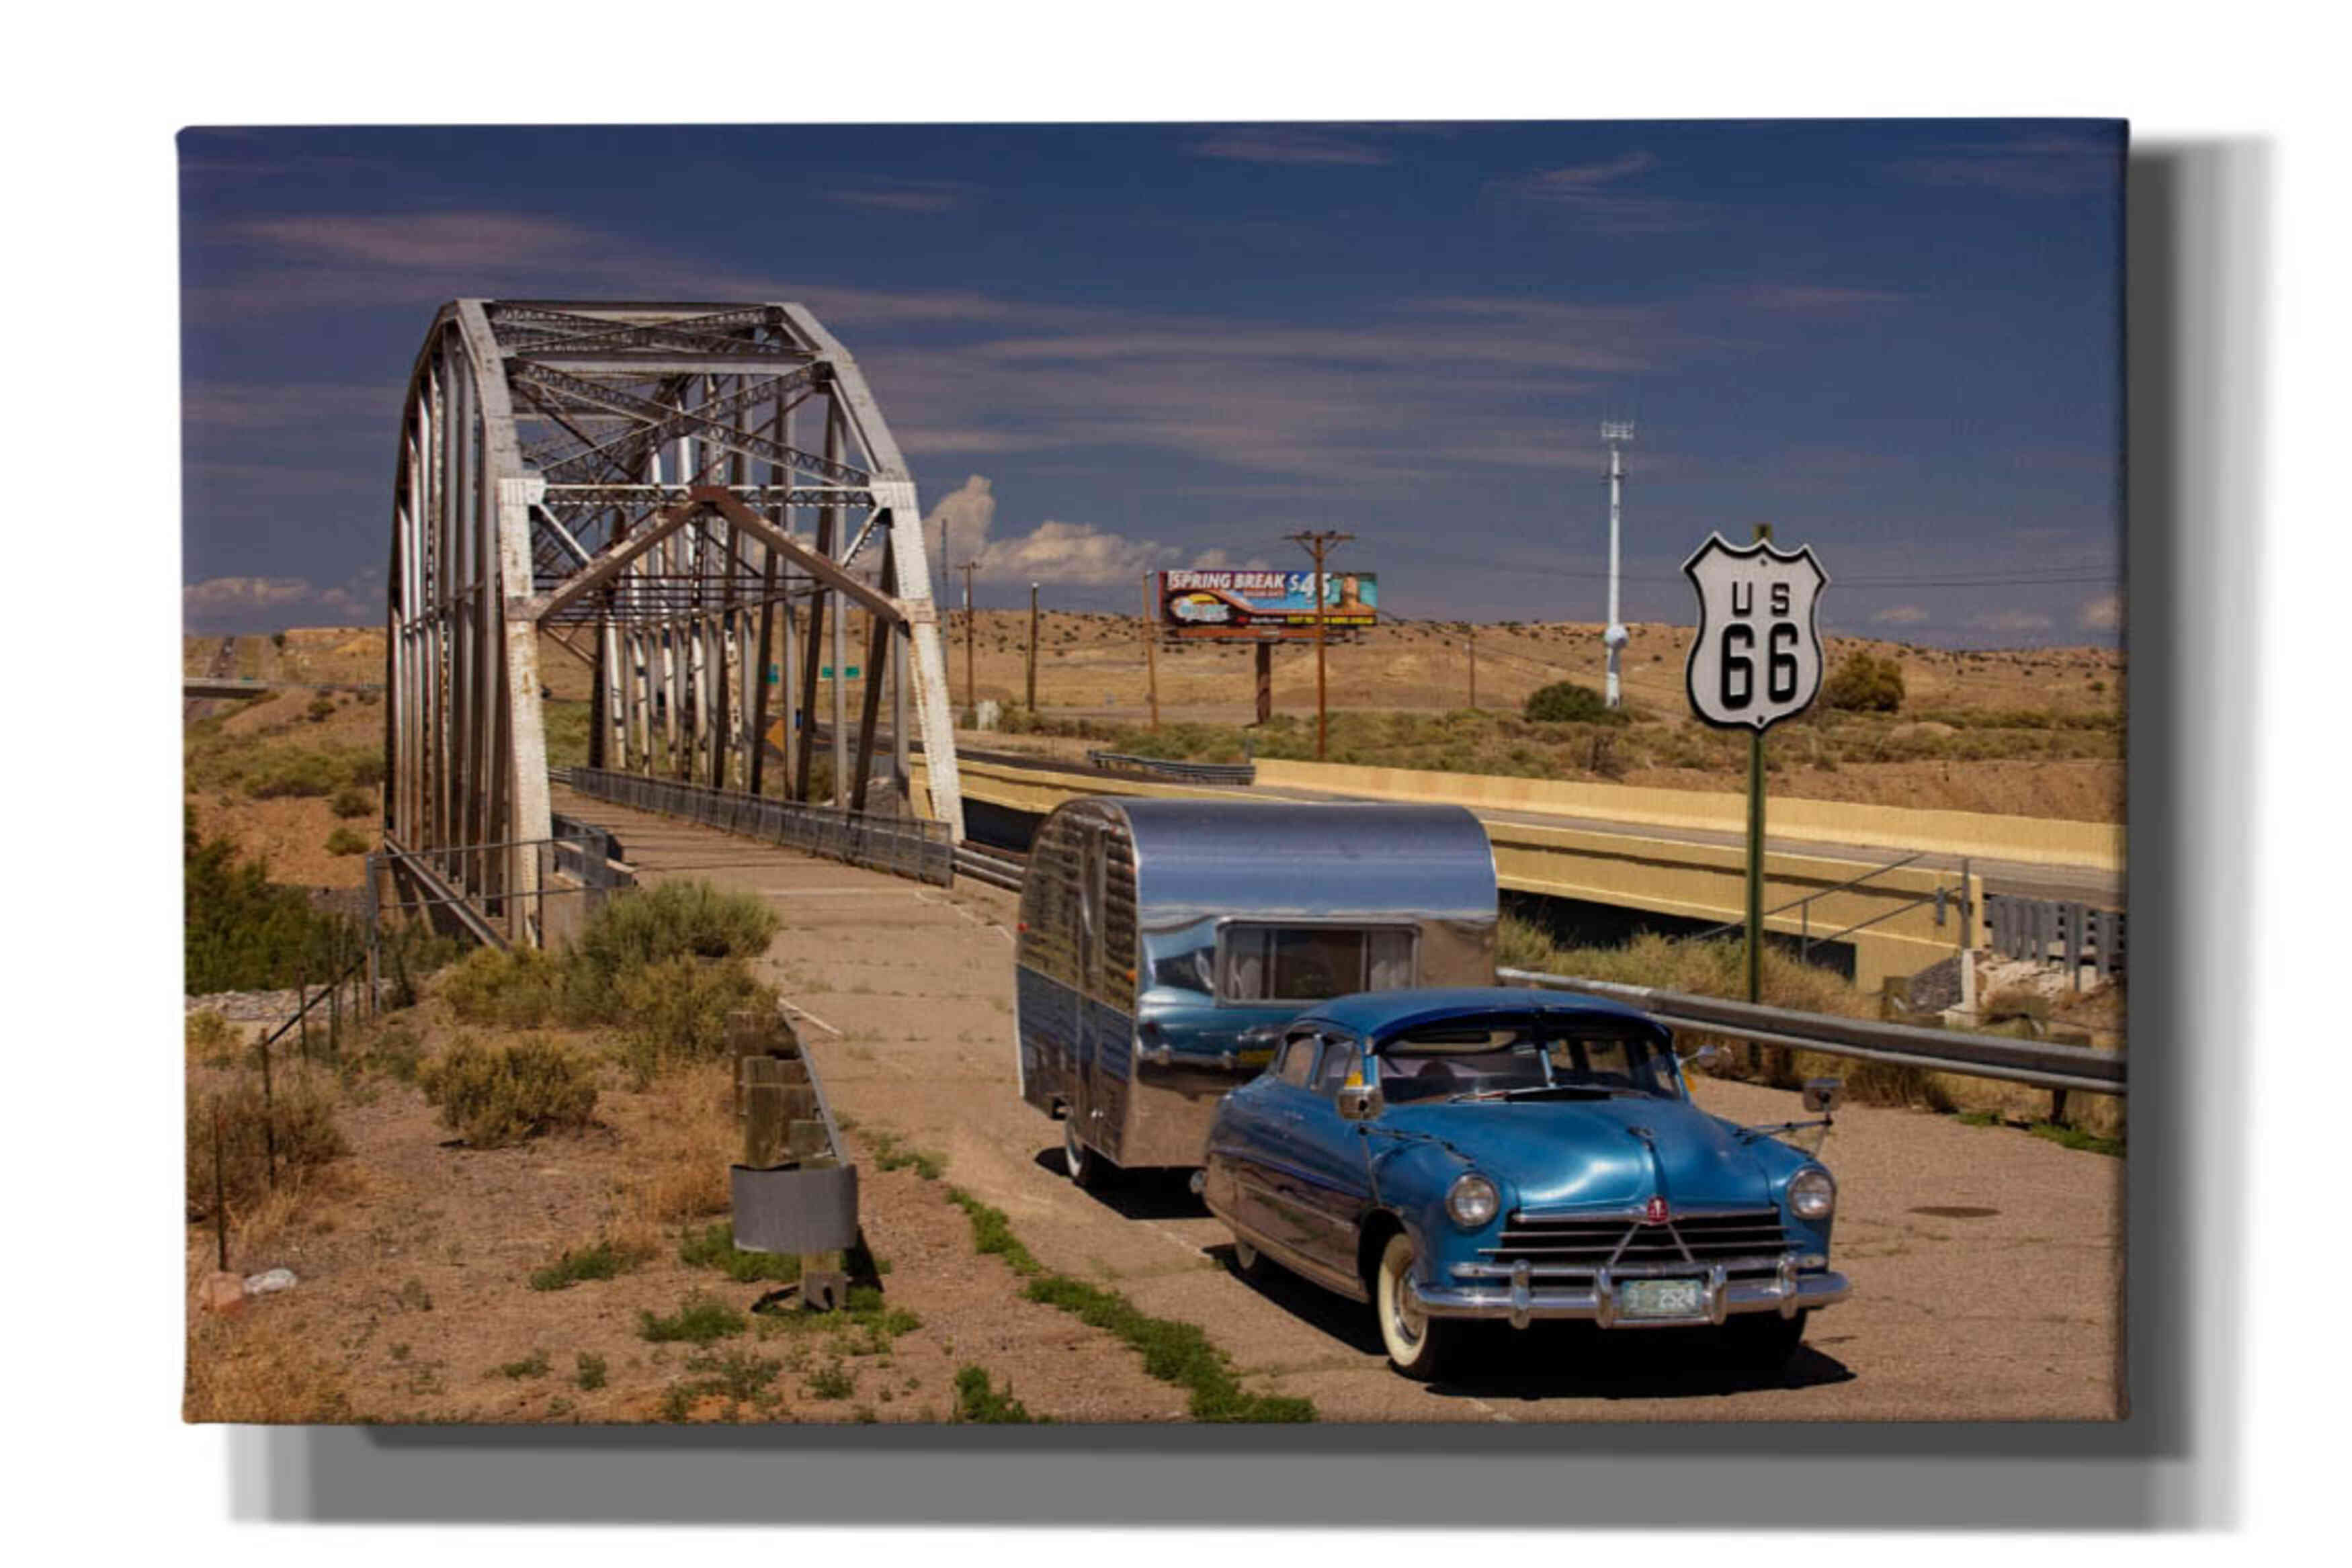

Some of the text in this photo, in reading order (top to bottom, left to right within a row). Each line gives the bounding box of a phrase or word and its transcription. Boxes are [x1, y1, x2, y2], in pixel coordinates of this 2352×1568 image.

[1234, 572, 1286, 589] BREAK
[1732, 580, 1790, 617] US
[1721, 622, 1798, 711] 66
